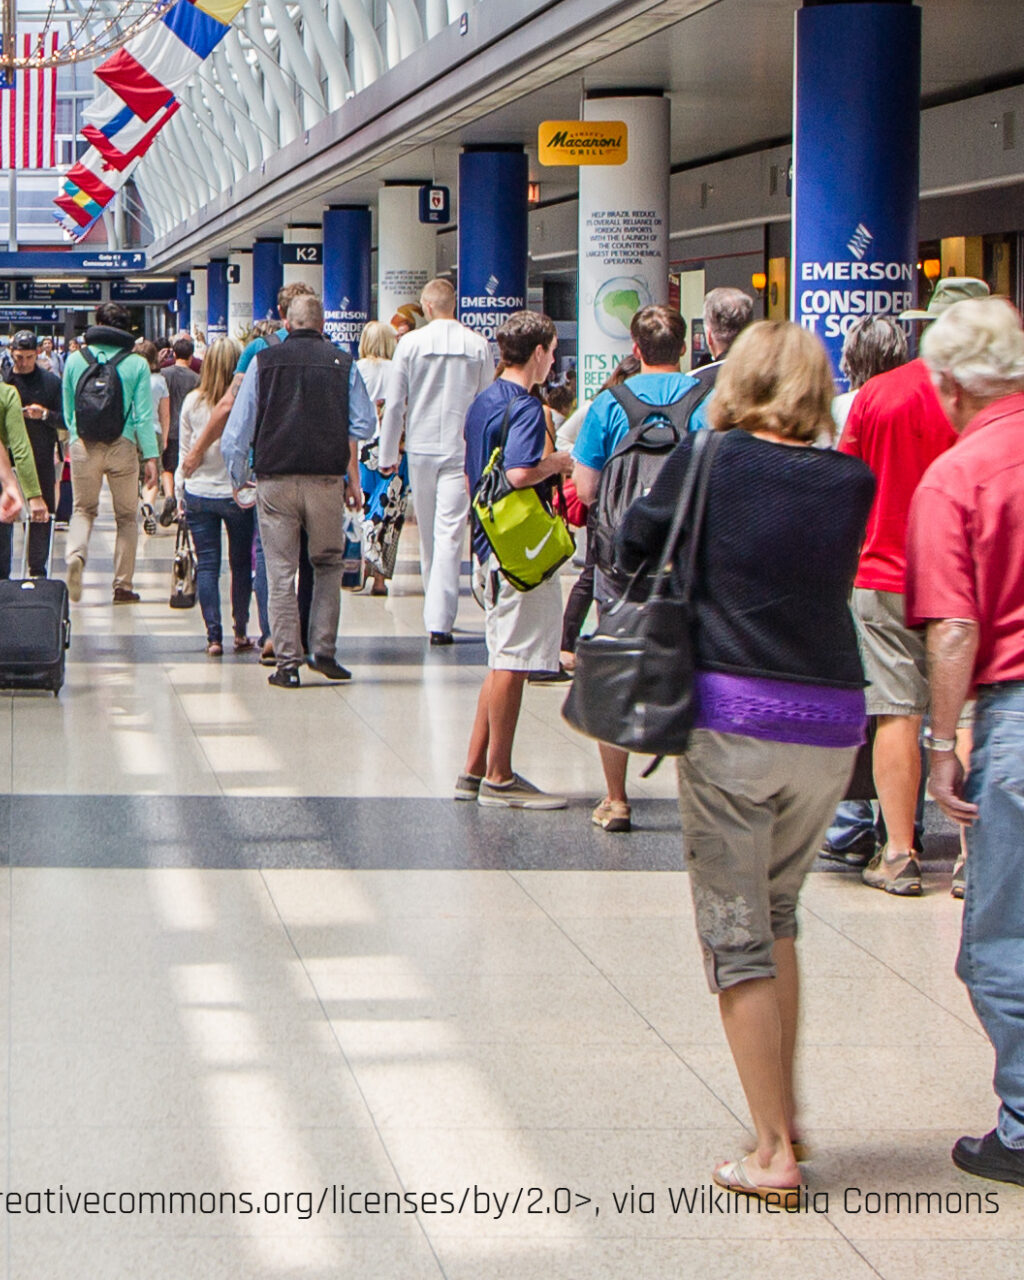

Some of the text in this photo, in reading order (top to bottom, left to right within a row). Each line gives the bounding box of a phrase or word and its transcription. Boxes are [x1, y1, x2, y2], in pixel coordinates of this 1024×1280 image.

[547, 131, 623, 148] Macaroni
[296, 248, 318, 261] K2
[801, 262, 913, 281] EMERSON
[461, 296, 524, 308] EMERSON
[800, 289, 913, 314] CONSIDER
[324, 311, 368, 320] EMERSON
[461, 312, 512, 326] CONSID
[324, 322, 365, 332] CONSIDE
[800, 314, 820, 334] IT
[331, 332, 361, 342] SOLV
[584, 354, 607, 370] IT'S
